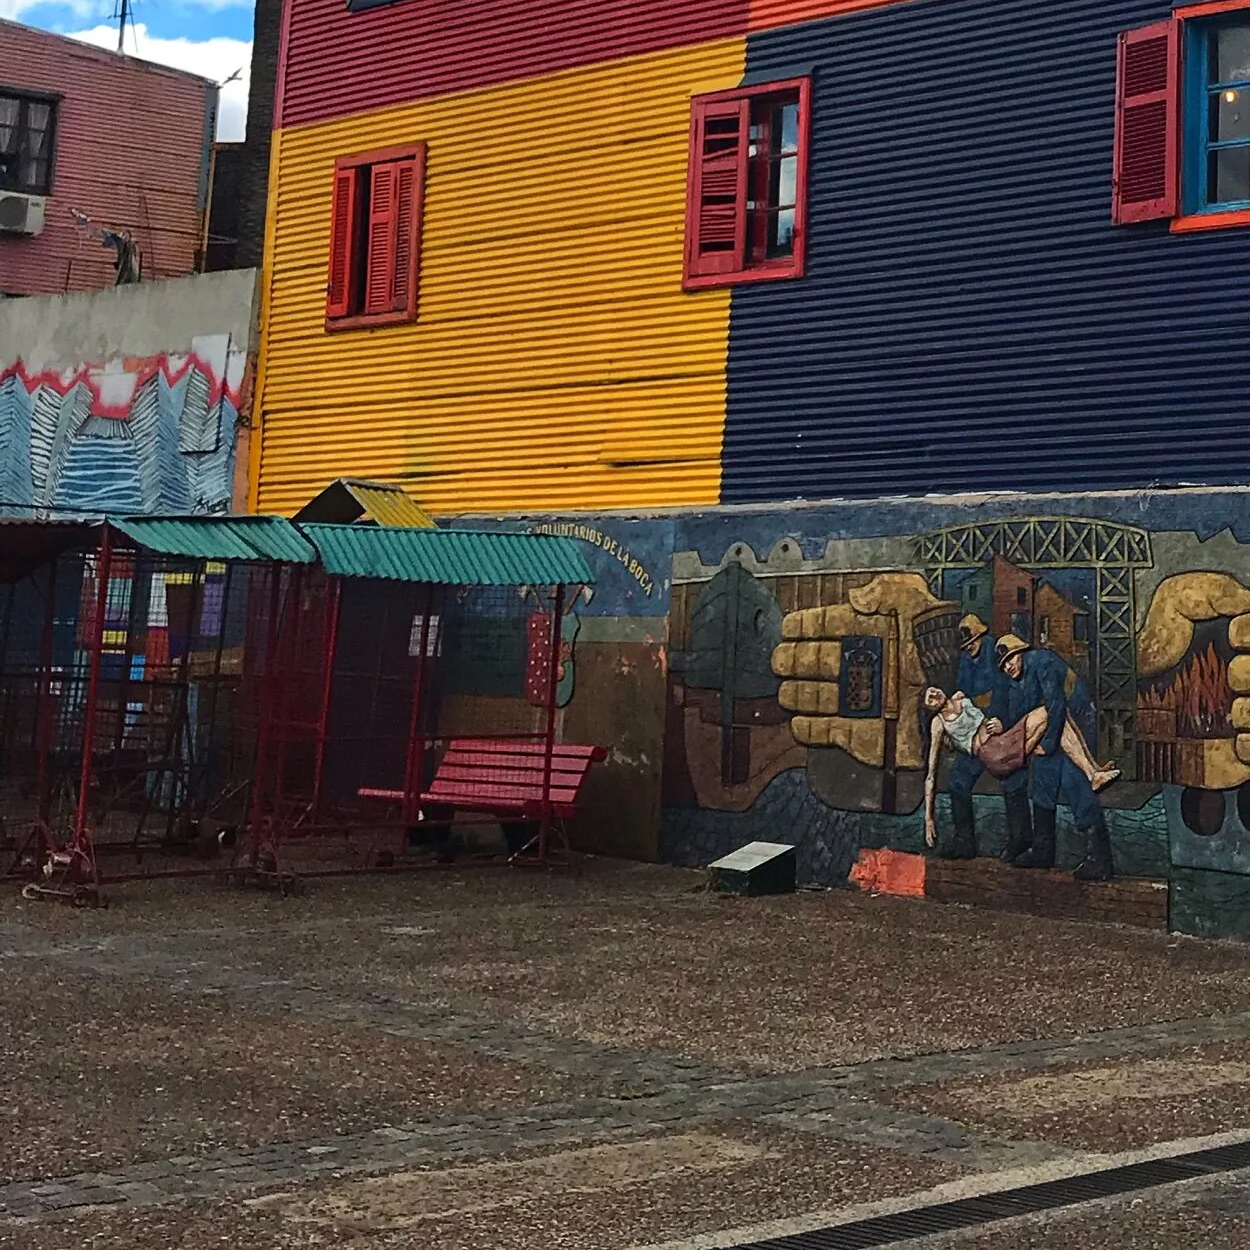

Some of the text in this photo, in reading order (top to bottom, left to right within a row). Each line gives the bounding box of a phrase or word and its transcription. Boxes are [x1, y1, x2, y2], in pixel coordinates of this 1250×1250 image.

[536, 524, 654, 597] VOLUNTARIOS DE LA BOCA
